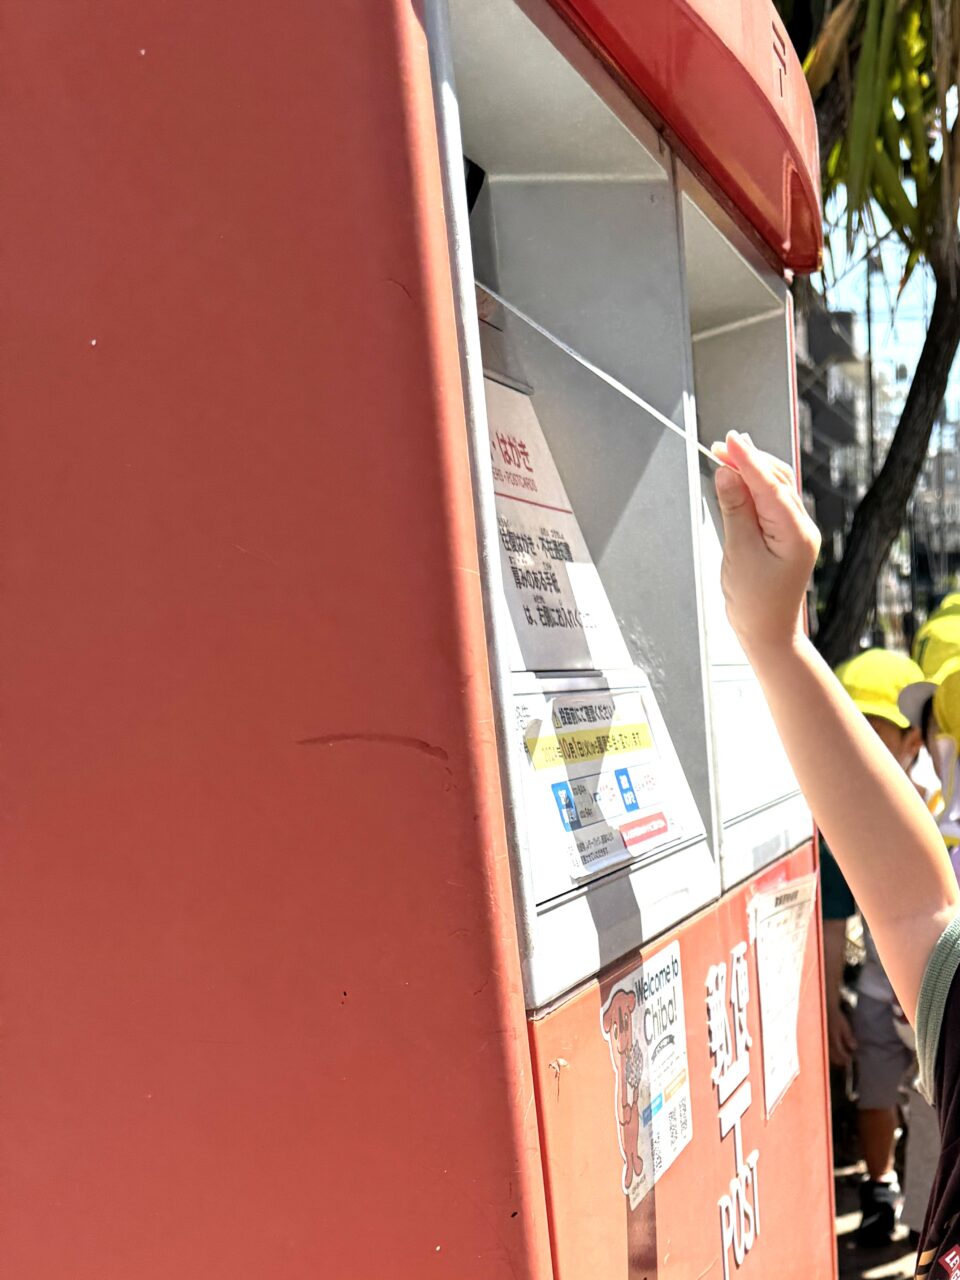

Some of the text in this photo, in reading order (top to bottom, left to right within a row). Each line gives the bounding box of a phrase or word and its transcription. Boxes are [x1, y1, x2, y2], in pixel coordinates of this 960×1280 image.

[634, 954, 679, 1008] Welcome to
[643, 985, 678, 1046] Chiba!
[704, 940, 753, 1085] 郵便
